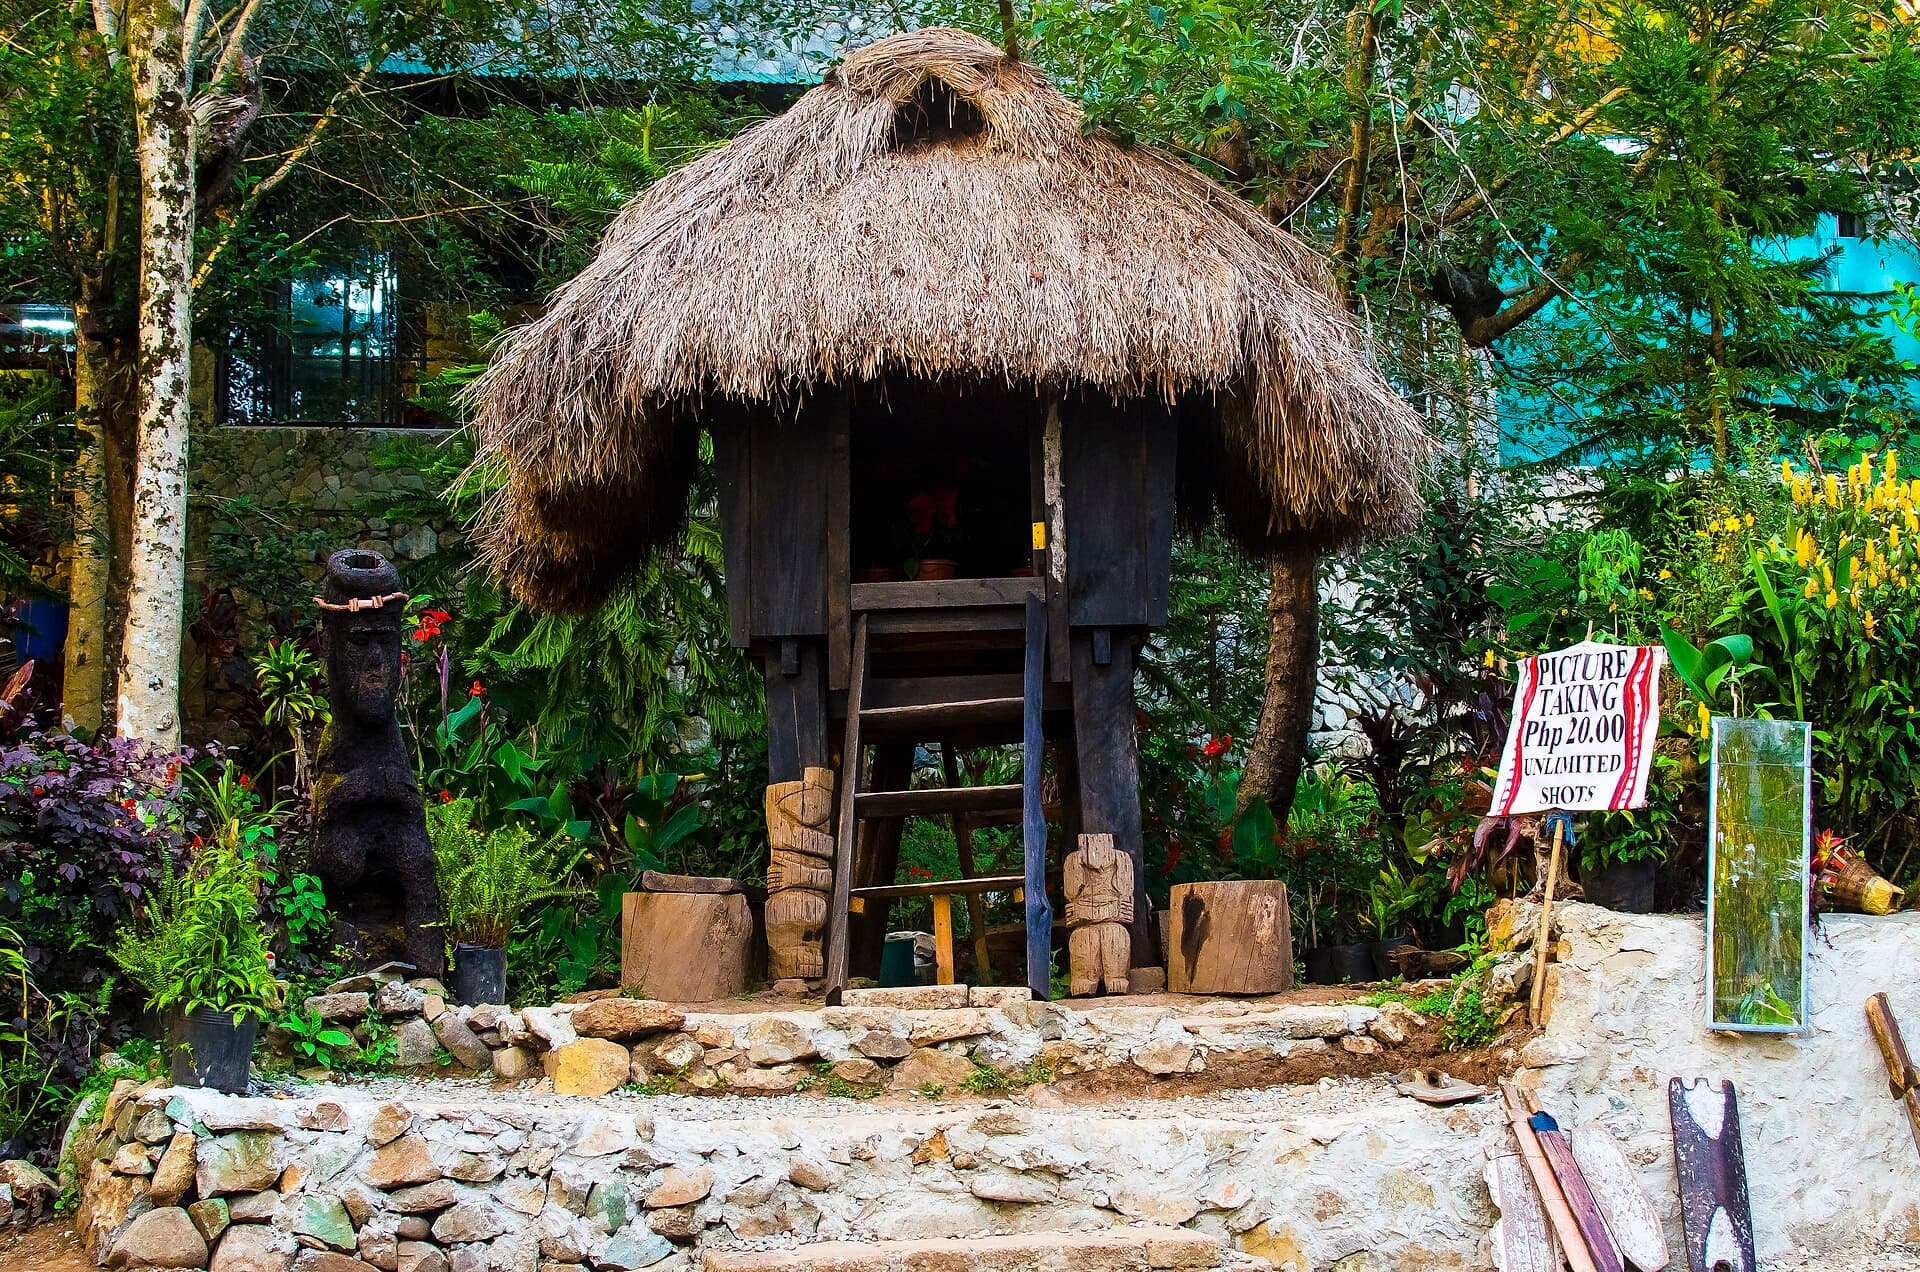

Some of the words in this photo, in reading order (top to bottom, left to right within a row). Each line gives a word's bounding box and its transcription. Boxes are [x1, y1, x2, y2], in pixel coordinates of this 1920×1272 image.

[1539, 649, 1628, 686] PICTURE
[1540, 682, 1619, 717] TAKING
[1524, 720, 1563, 754] Php
[1566, 714, 1625, 744] 20.00
[1524, 754, 1621, 777] UNLIMITED
[1539, 785, 1597, 805] SHOTS
